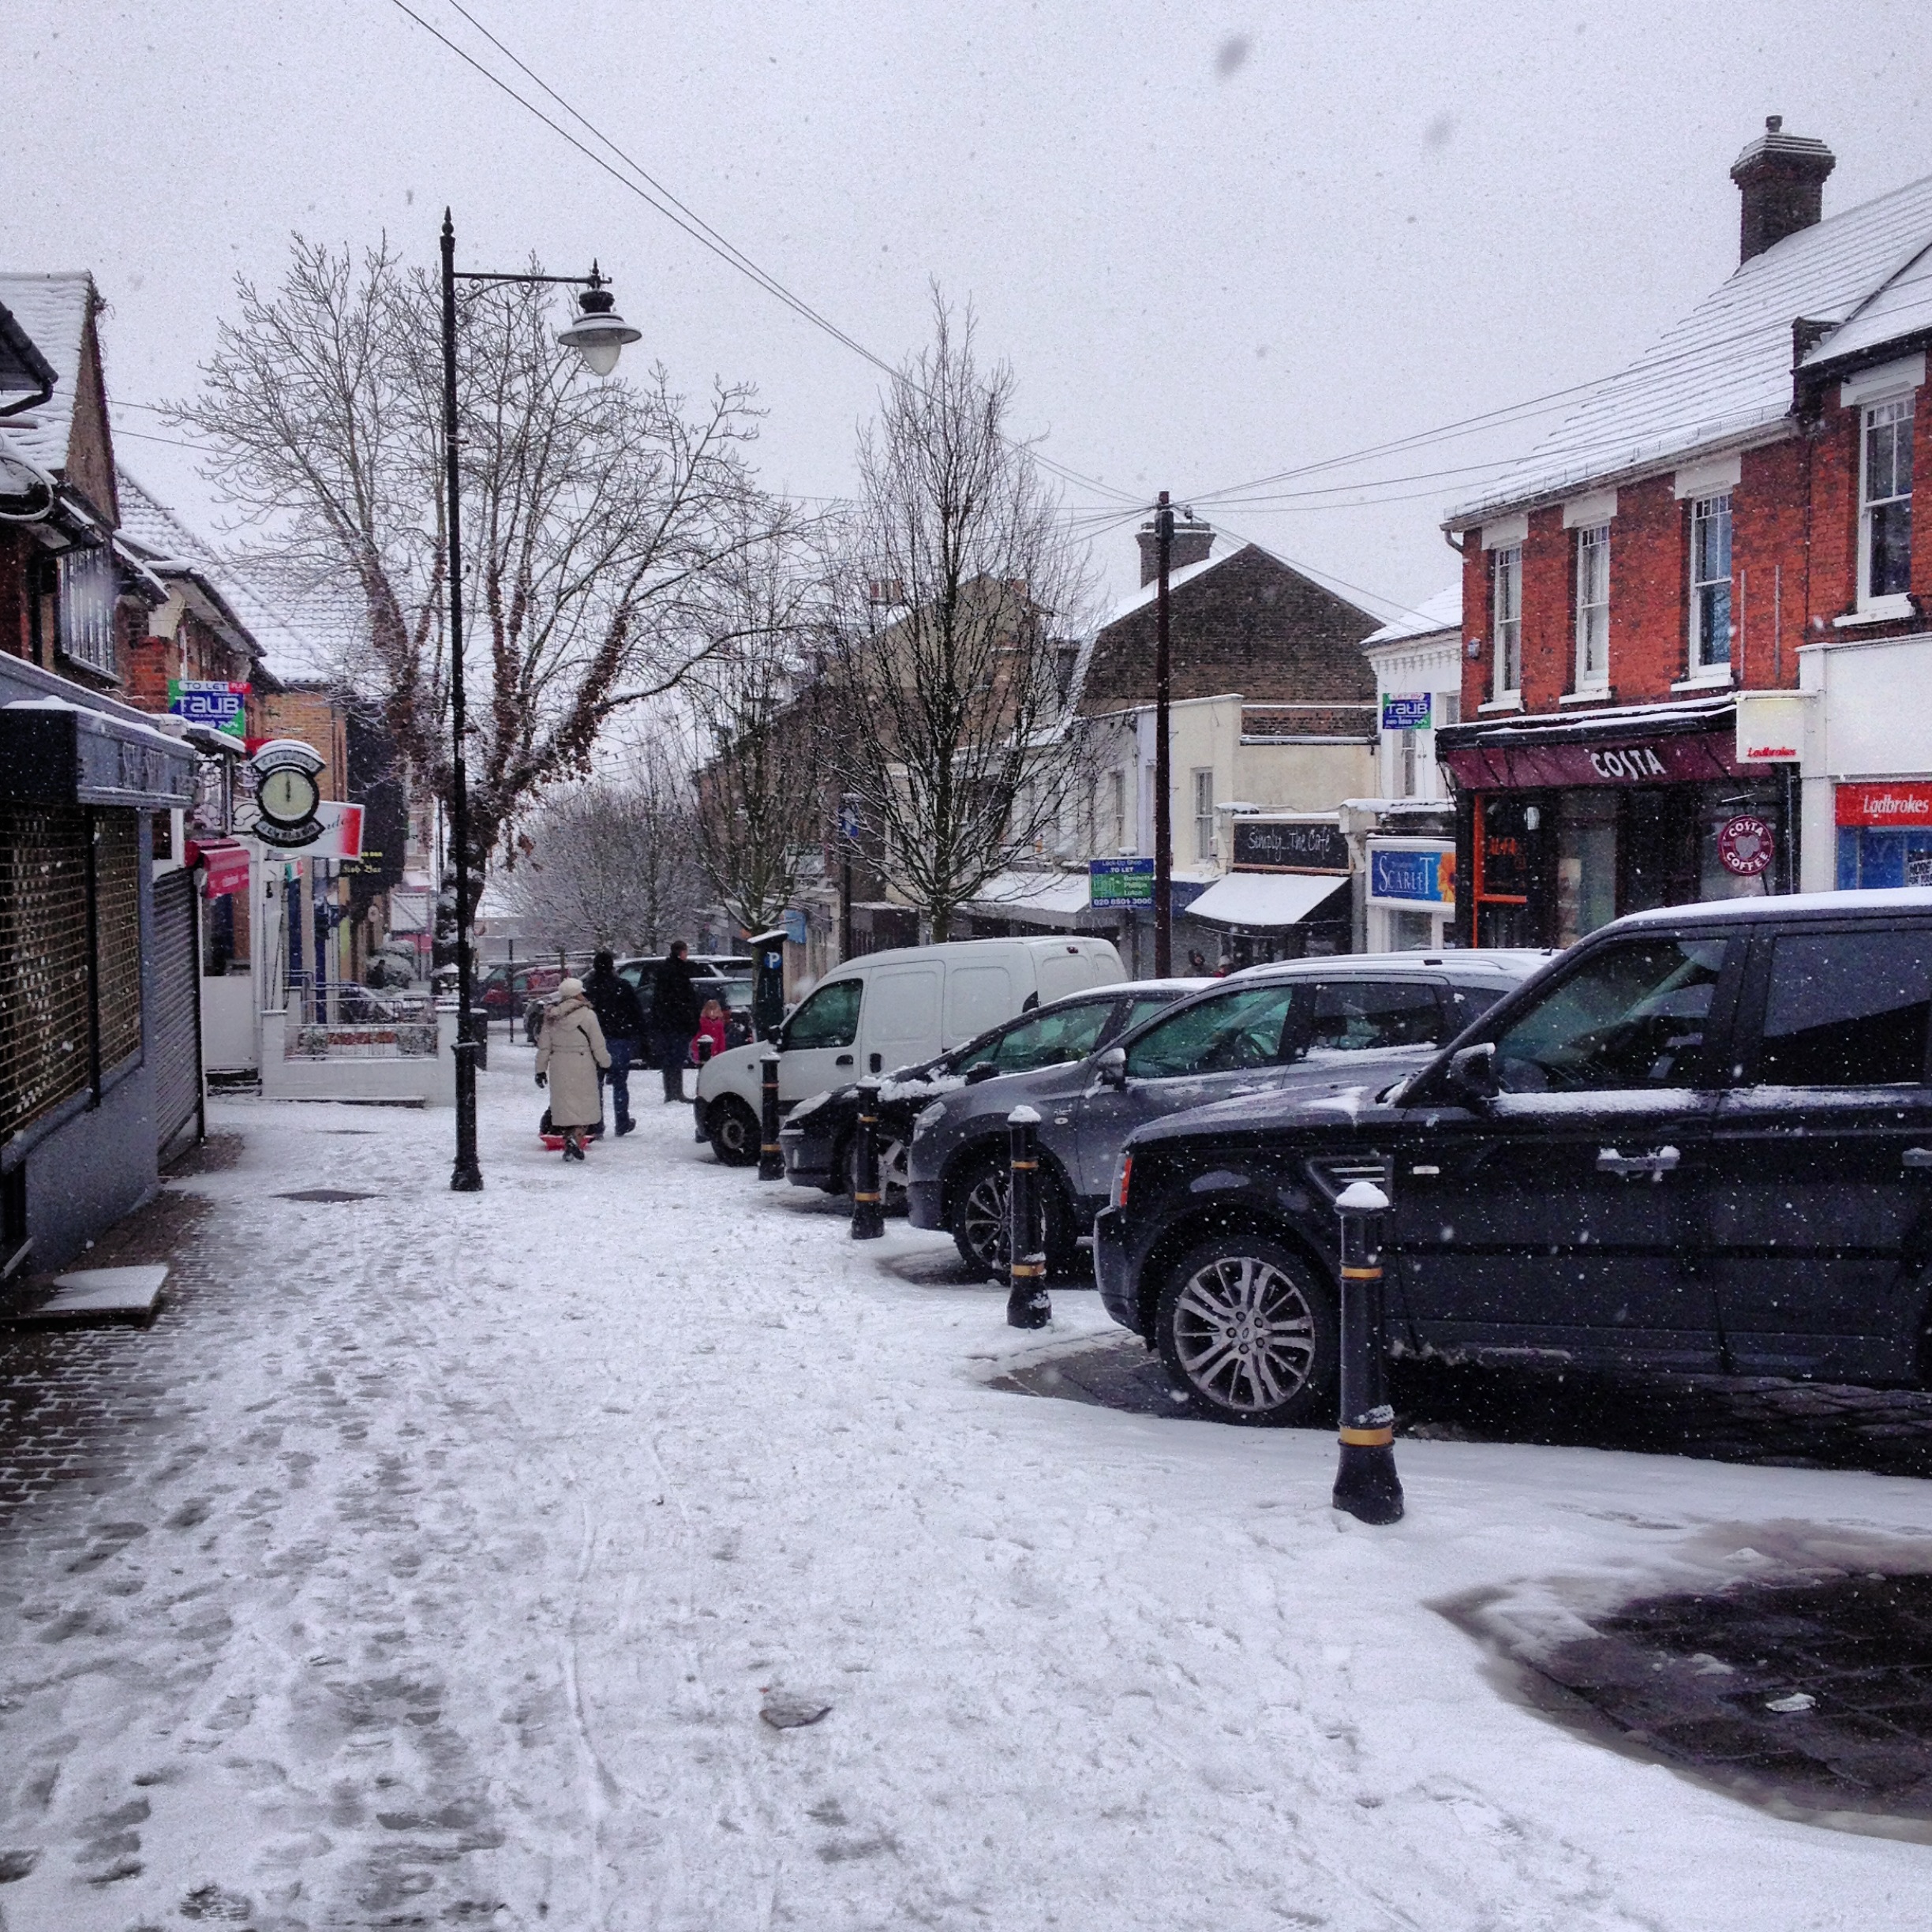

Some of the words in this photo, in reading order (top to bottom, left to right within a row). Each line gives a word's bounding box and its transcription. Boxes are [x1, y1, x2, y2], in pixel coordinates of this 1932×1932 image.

[1590, 749, 1667, 781] COSTA
[1863, 794, 1930, 814] Ladbrokes
[1728, 821, 1764, 837] COSTA
[1726, 851, 1768, 871] COFFEE
[767, 952, 780, 969] P
